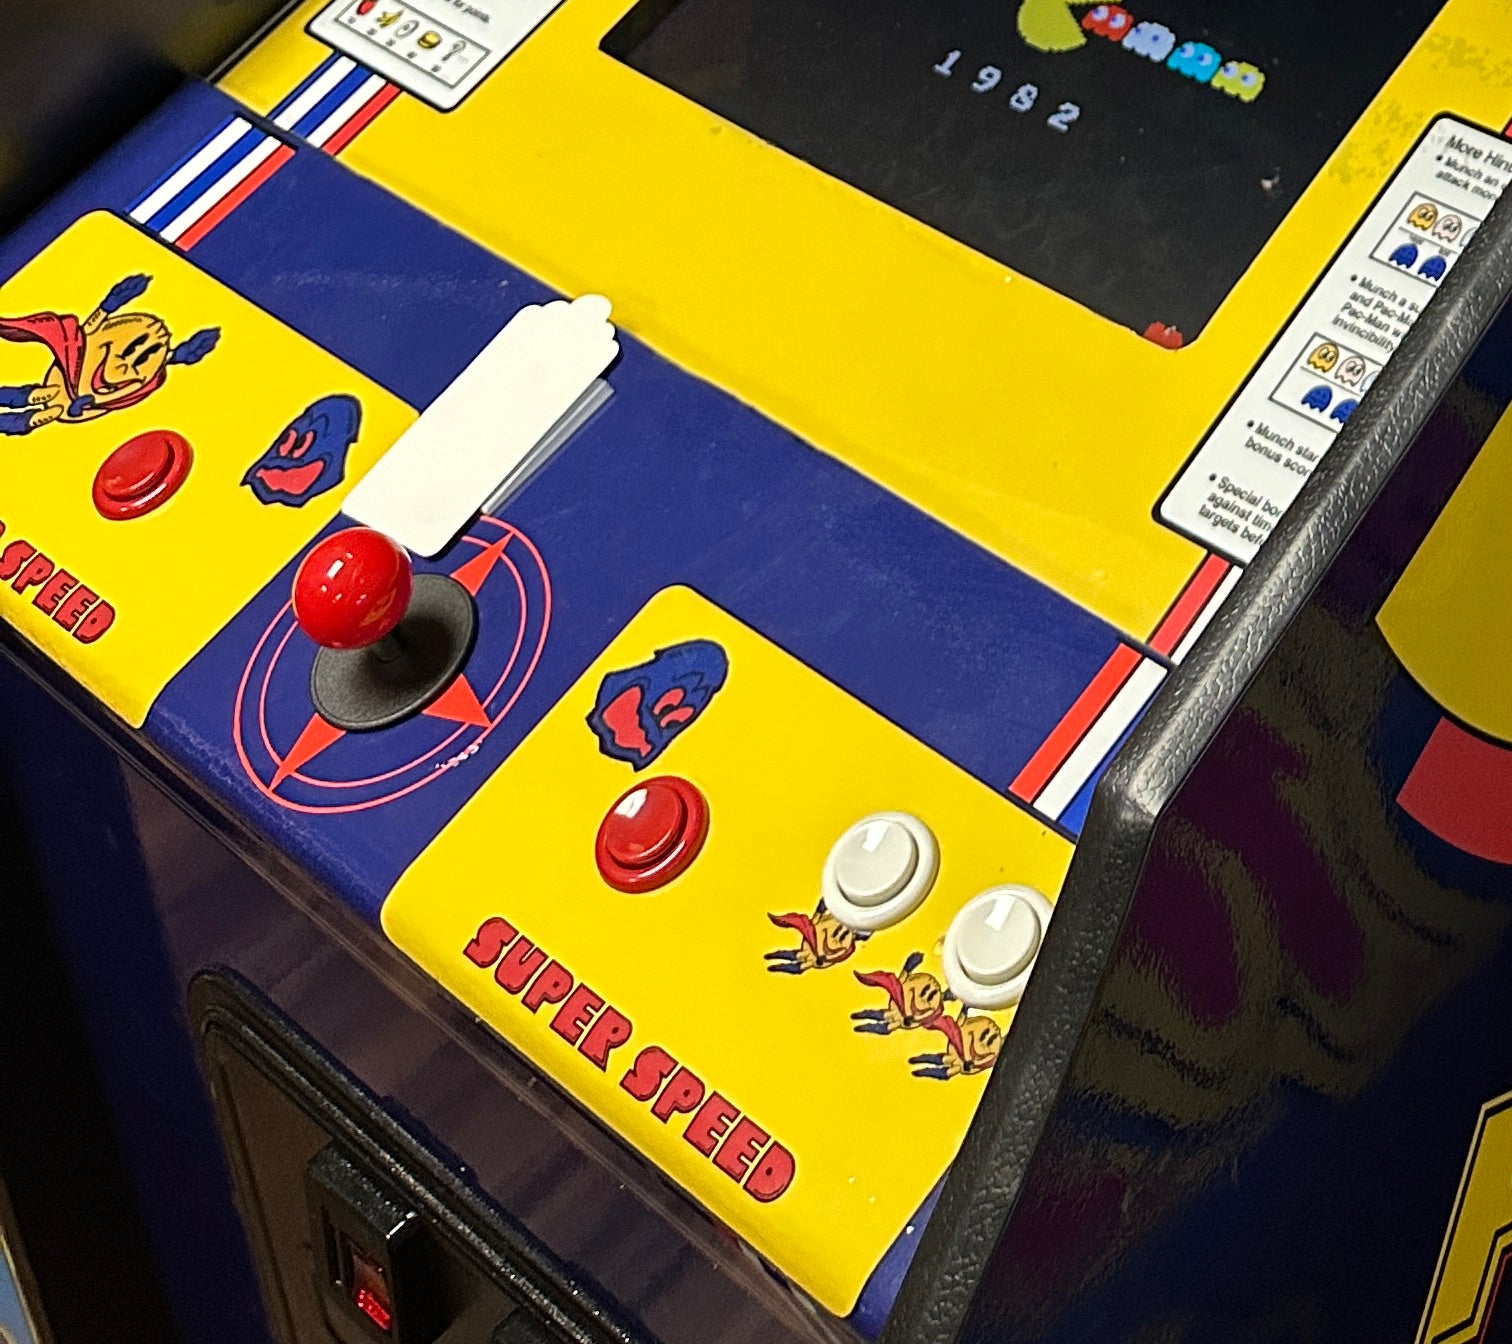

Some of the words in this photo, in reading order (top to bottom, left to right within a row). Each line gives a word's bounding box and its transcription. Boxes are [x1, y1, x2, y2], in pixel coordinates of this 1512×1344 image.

[1445, 134, 1483, 159] More
[1349, 291, 1374, 307] and
[1358, 276, 1398, 302] Munch
[1398, 297, 1407, 307] a
[1340, 301, 1391, 332] Pac-Man
[1245, 436, 1283, 463] bonus
[1255, 422, 1295, 451] Munch
[1218, 475, 1264, 507] Special
[1198, 504, 1240, 534] targets
[1207, 492, 1253, 522] against
[0, 539, 116, 644] SPEED
[462, 916, 633, 1070] SUPER
[620, 1045, 796, 1203] SPEED
